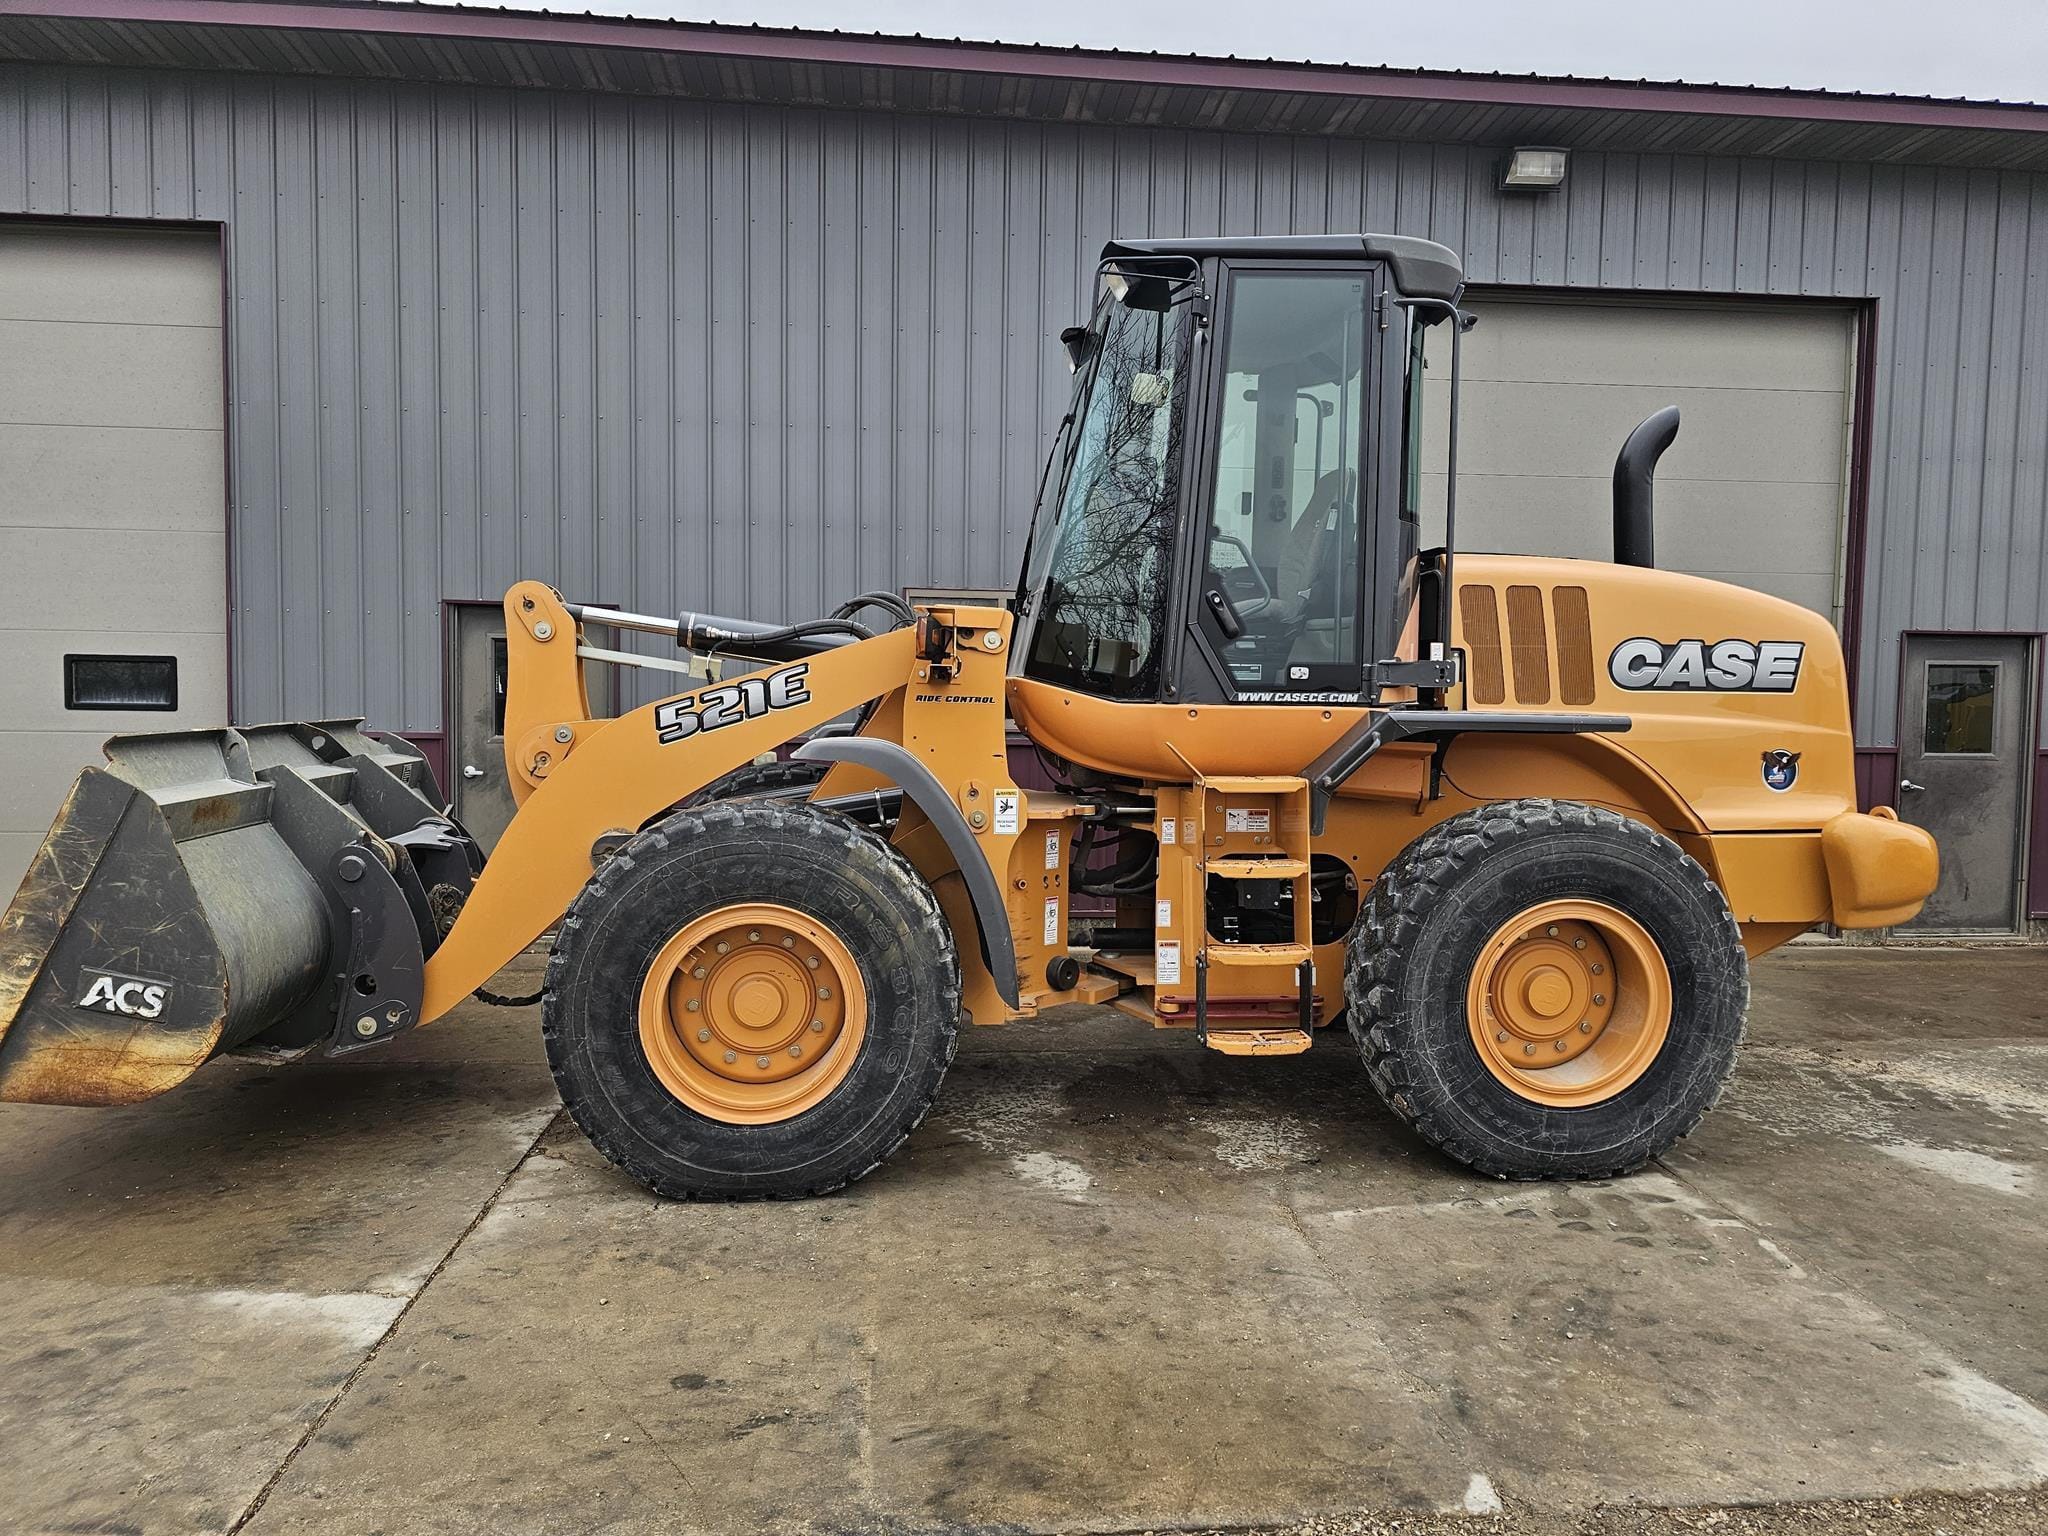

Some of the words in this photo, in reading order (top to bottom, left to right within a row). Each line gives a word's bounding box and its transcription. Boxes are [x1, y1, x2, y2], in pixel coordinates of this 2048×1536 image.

[1609, 638, 1803, 690] CASE
[655, 663, 811, 744] 521E
[915, 694, 942, 703] RIDE
[945, 695, 996, 704] CONTROL
[1237, 691, 1359, 703] WWW.CASECE.COM
[79, 976, 167, 1019] ACS
